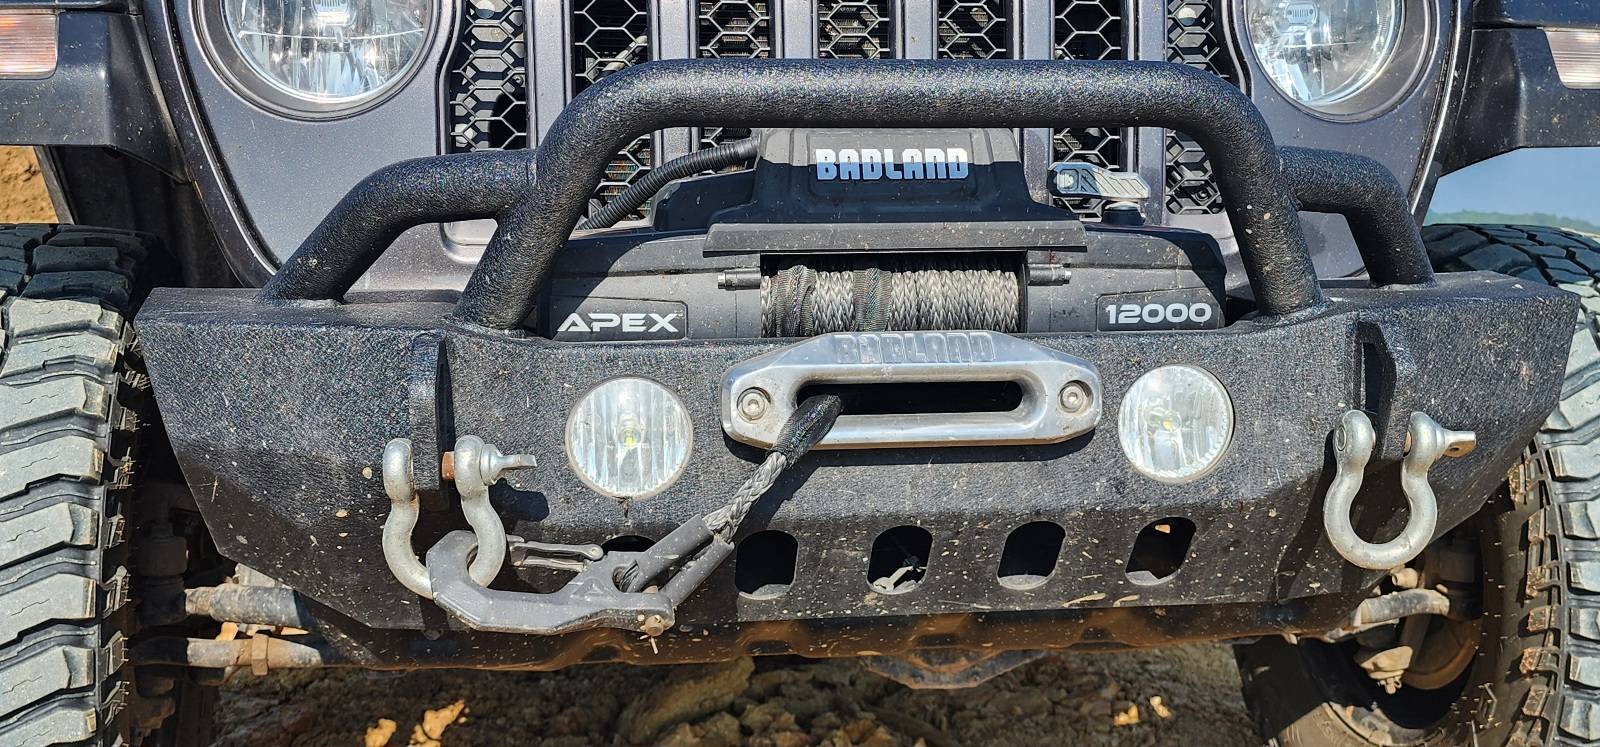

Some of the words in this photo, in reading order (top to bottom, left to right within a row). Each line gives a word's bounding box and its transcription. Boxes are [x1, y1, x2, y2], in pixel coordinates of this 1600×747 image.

[815, 148, 969, 180] BADLAND
[556, 312, 679, 333] APEX
[1105, 302, 1212, 324] 12000
[833, 332, 996, 364] BADLAND
